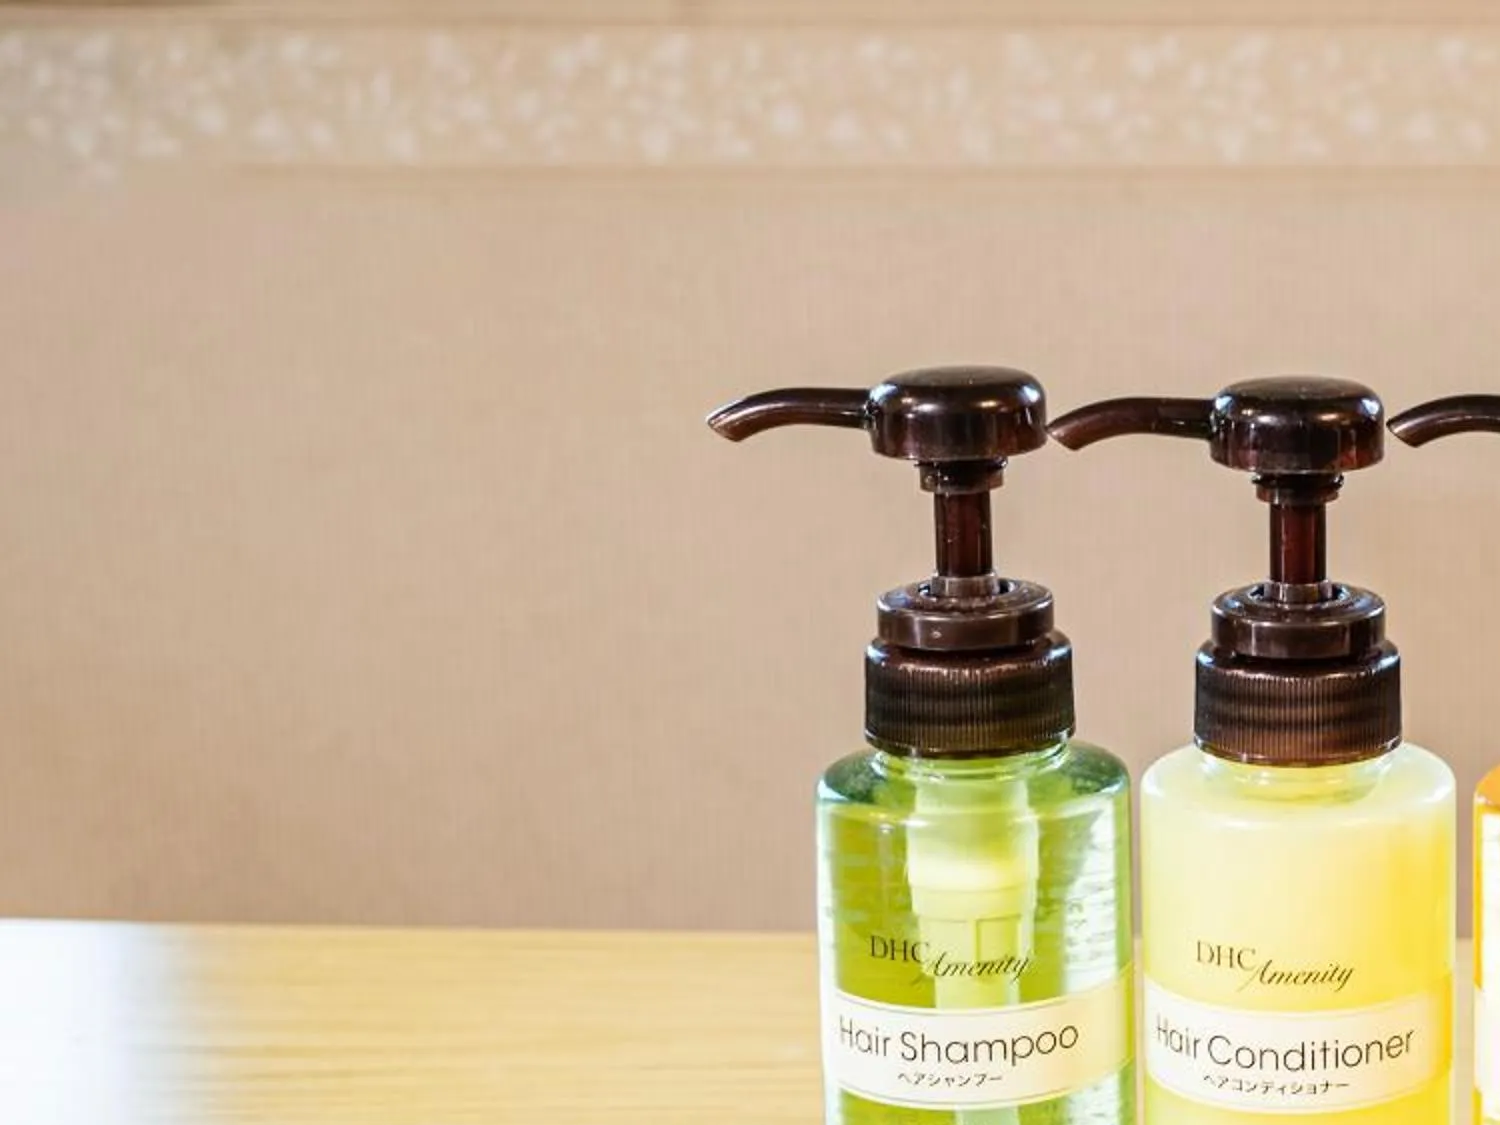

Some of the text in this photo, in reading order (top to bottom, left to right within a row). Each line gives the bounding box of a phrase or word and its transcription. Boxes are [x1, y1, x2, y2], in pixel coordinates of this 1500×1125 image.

[871, 935, 1031, 985] DHC Amenity
[1197, 940, 1355, 992] DHC Amenity
[840, 1015, 1079, 1066] Hair Shampoo
[1157, 1013, 1414, 1072] Hair Conditioner
